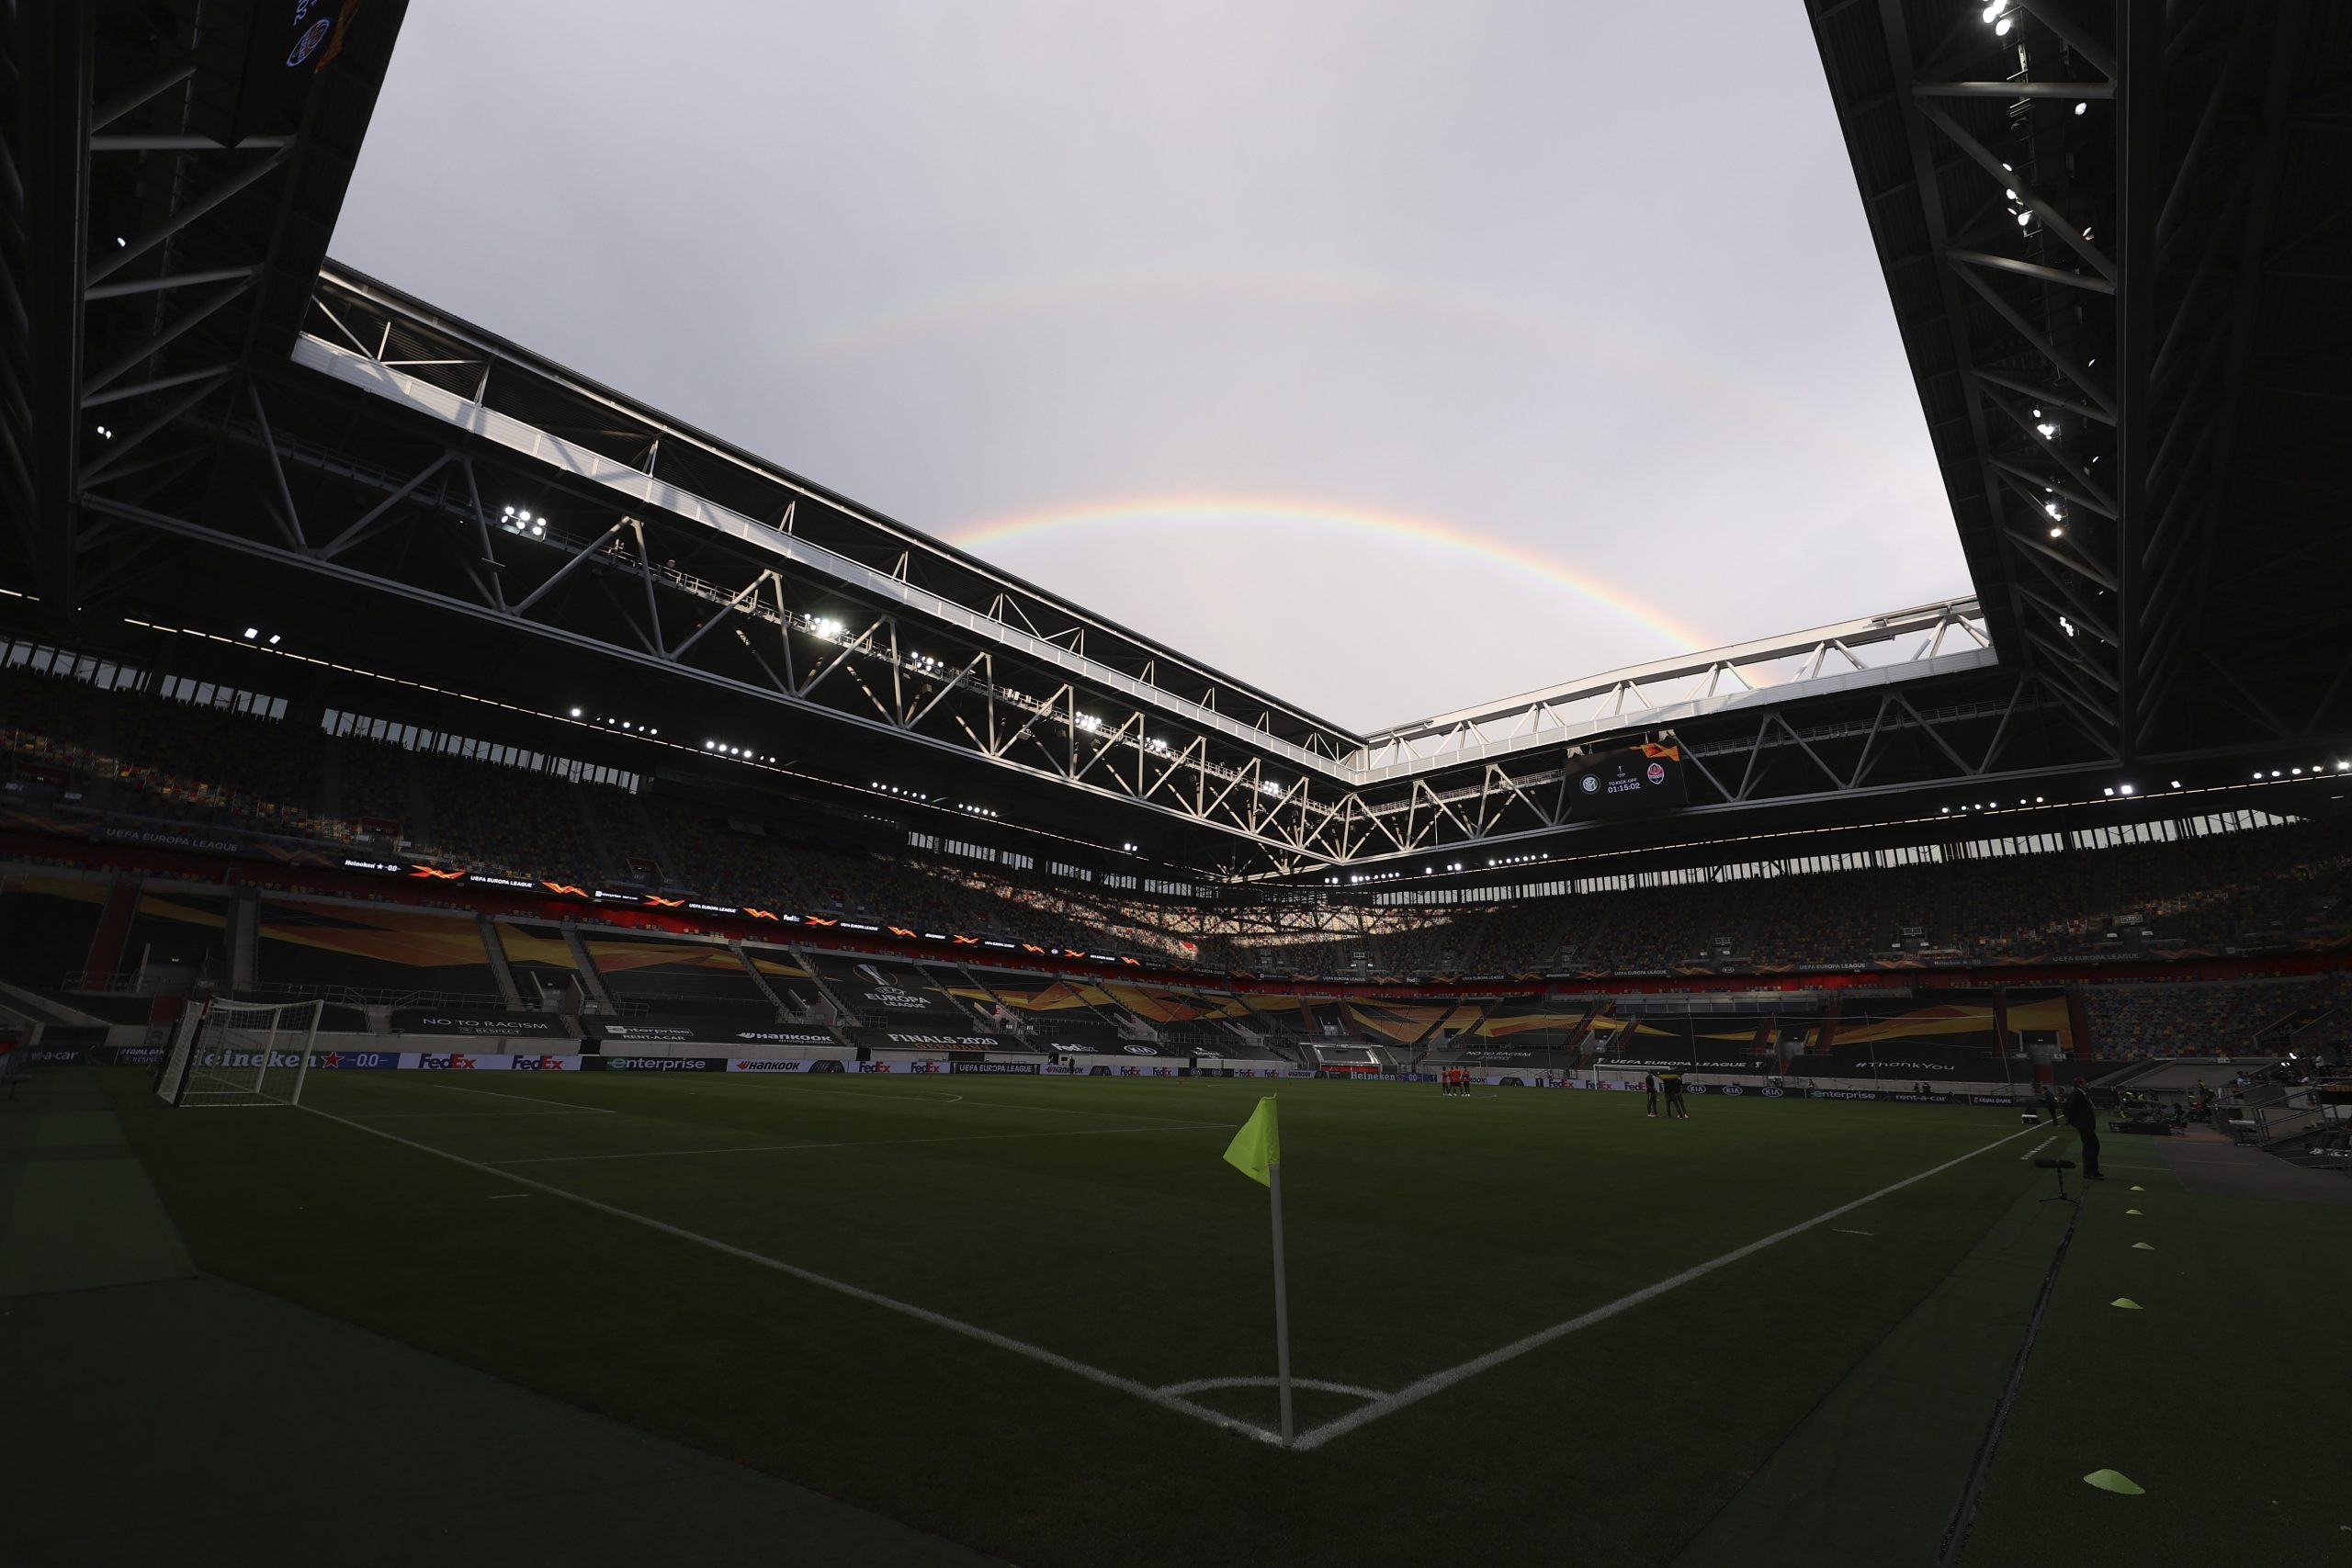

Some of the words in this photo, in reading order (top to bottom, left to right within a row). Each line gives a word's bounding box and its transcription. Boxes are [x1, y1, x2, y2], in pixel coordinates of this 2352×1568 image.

[1607, 782, 1641, 794] 01:15:02
[106, 829, 140, 840] UEFA
[141, 832, 189, 846] EUROPA
[192, 839, 239, 852] LEAGUE
[345, 859, 376, 869] Heineken
[487, 877, 510, 886] EUROPA
[510, 879, 533, 888] LEAGUE
[2052, 954, 2074, 964] UEFA
[2075, 953, 2106, 962] EUROPA
[2107, 952, 2140, 961] LEAGUE
[864, 993, 932, 1004] EUROPA
[883, 1000, 926, 1009] LEAGUE
[483, 1021, 548, 1029] RACISM
[887, 1033, 956, 1045] FINALS
[957, 1036, 1000, 1046] 2020
[418, 1054, 477, 1069] FedEx
[512, 1055, 563, 1070] FedEx
[611, 1058, 707, 1072] enterprise
[858, 1061, 891, 1073] FedEx
[1856, 1060, 1955, 1071] #ThankYou
[910, 1062, 940, 1073] FedEx
[959, 1064, 978, 1072] UEFA
[978, 1064, 1006, 1073] EUROPA
[1007, 1065, 1033, 1073] LEAGUE
[1120, 1066, 1140, 1076] FedEx
[1152, 1067, 1171, 1077] FedEx
[1238, 1069, 1255, 1077] FedEx
[1264, 1069, 1280, 1078] FedEx
[1350, 1072, 1396, 1081] Heineken
[1548, 1078, 1575, 1089] FedEx
[1624, 1081, 1647, 1091] FedE
[1814, 1089, 1876, 1100] enterprise
[1895, 1093, 1947, 1102] rent-a-car
